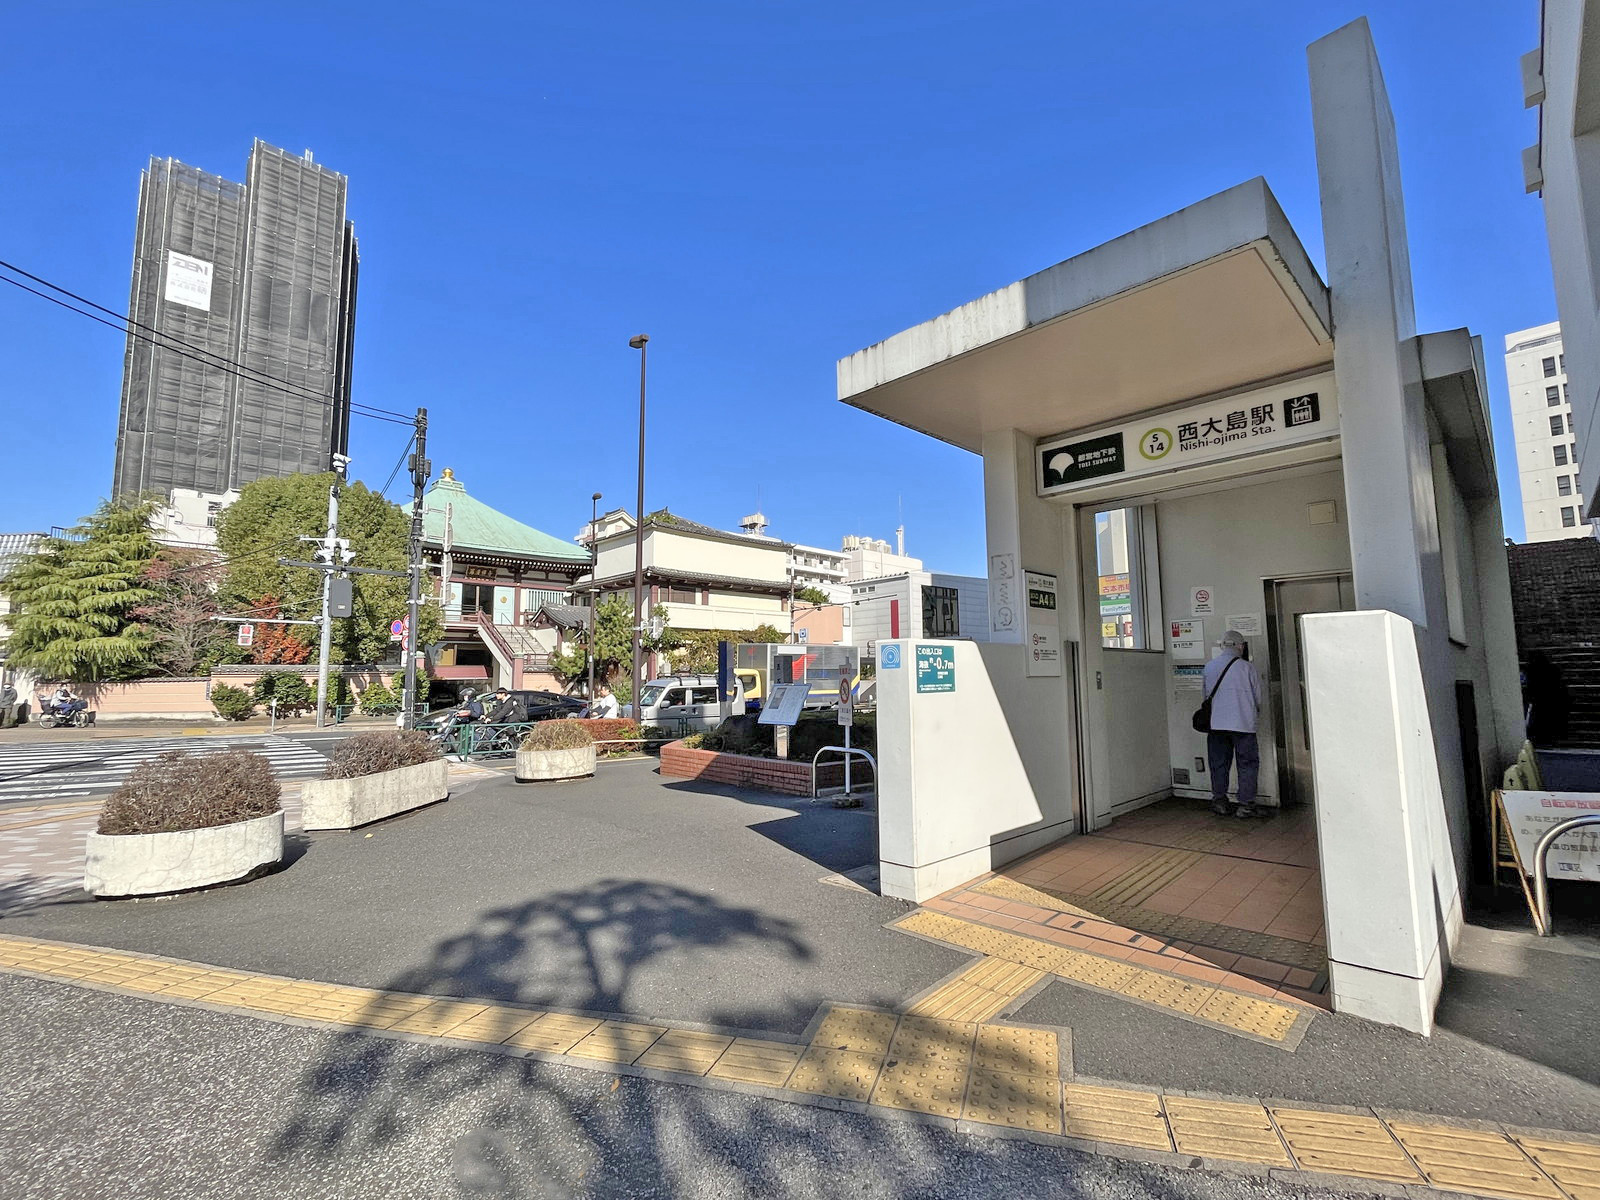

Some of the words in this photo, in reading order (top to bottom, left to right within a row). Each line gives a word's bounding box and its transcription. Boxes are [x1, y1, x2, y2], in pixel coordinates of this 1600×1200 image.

[1177, 403, 1275, 443] 西大島駅
[1152, 433, 1159, 443] S
[1180, 432, 1247, 452] Nishi-ojima
[1251, 425, 1276, 437] Sta.
[1149, 442, 1165, 454] 14
[1039, 593, 1049, 606] A4
